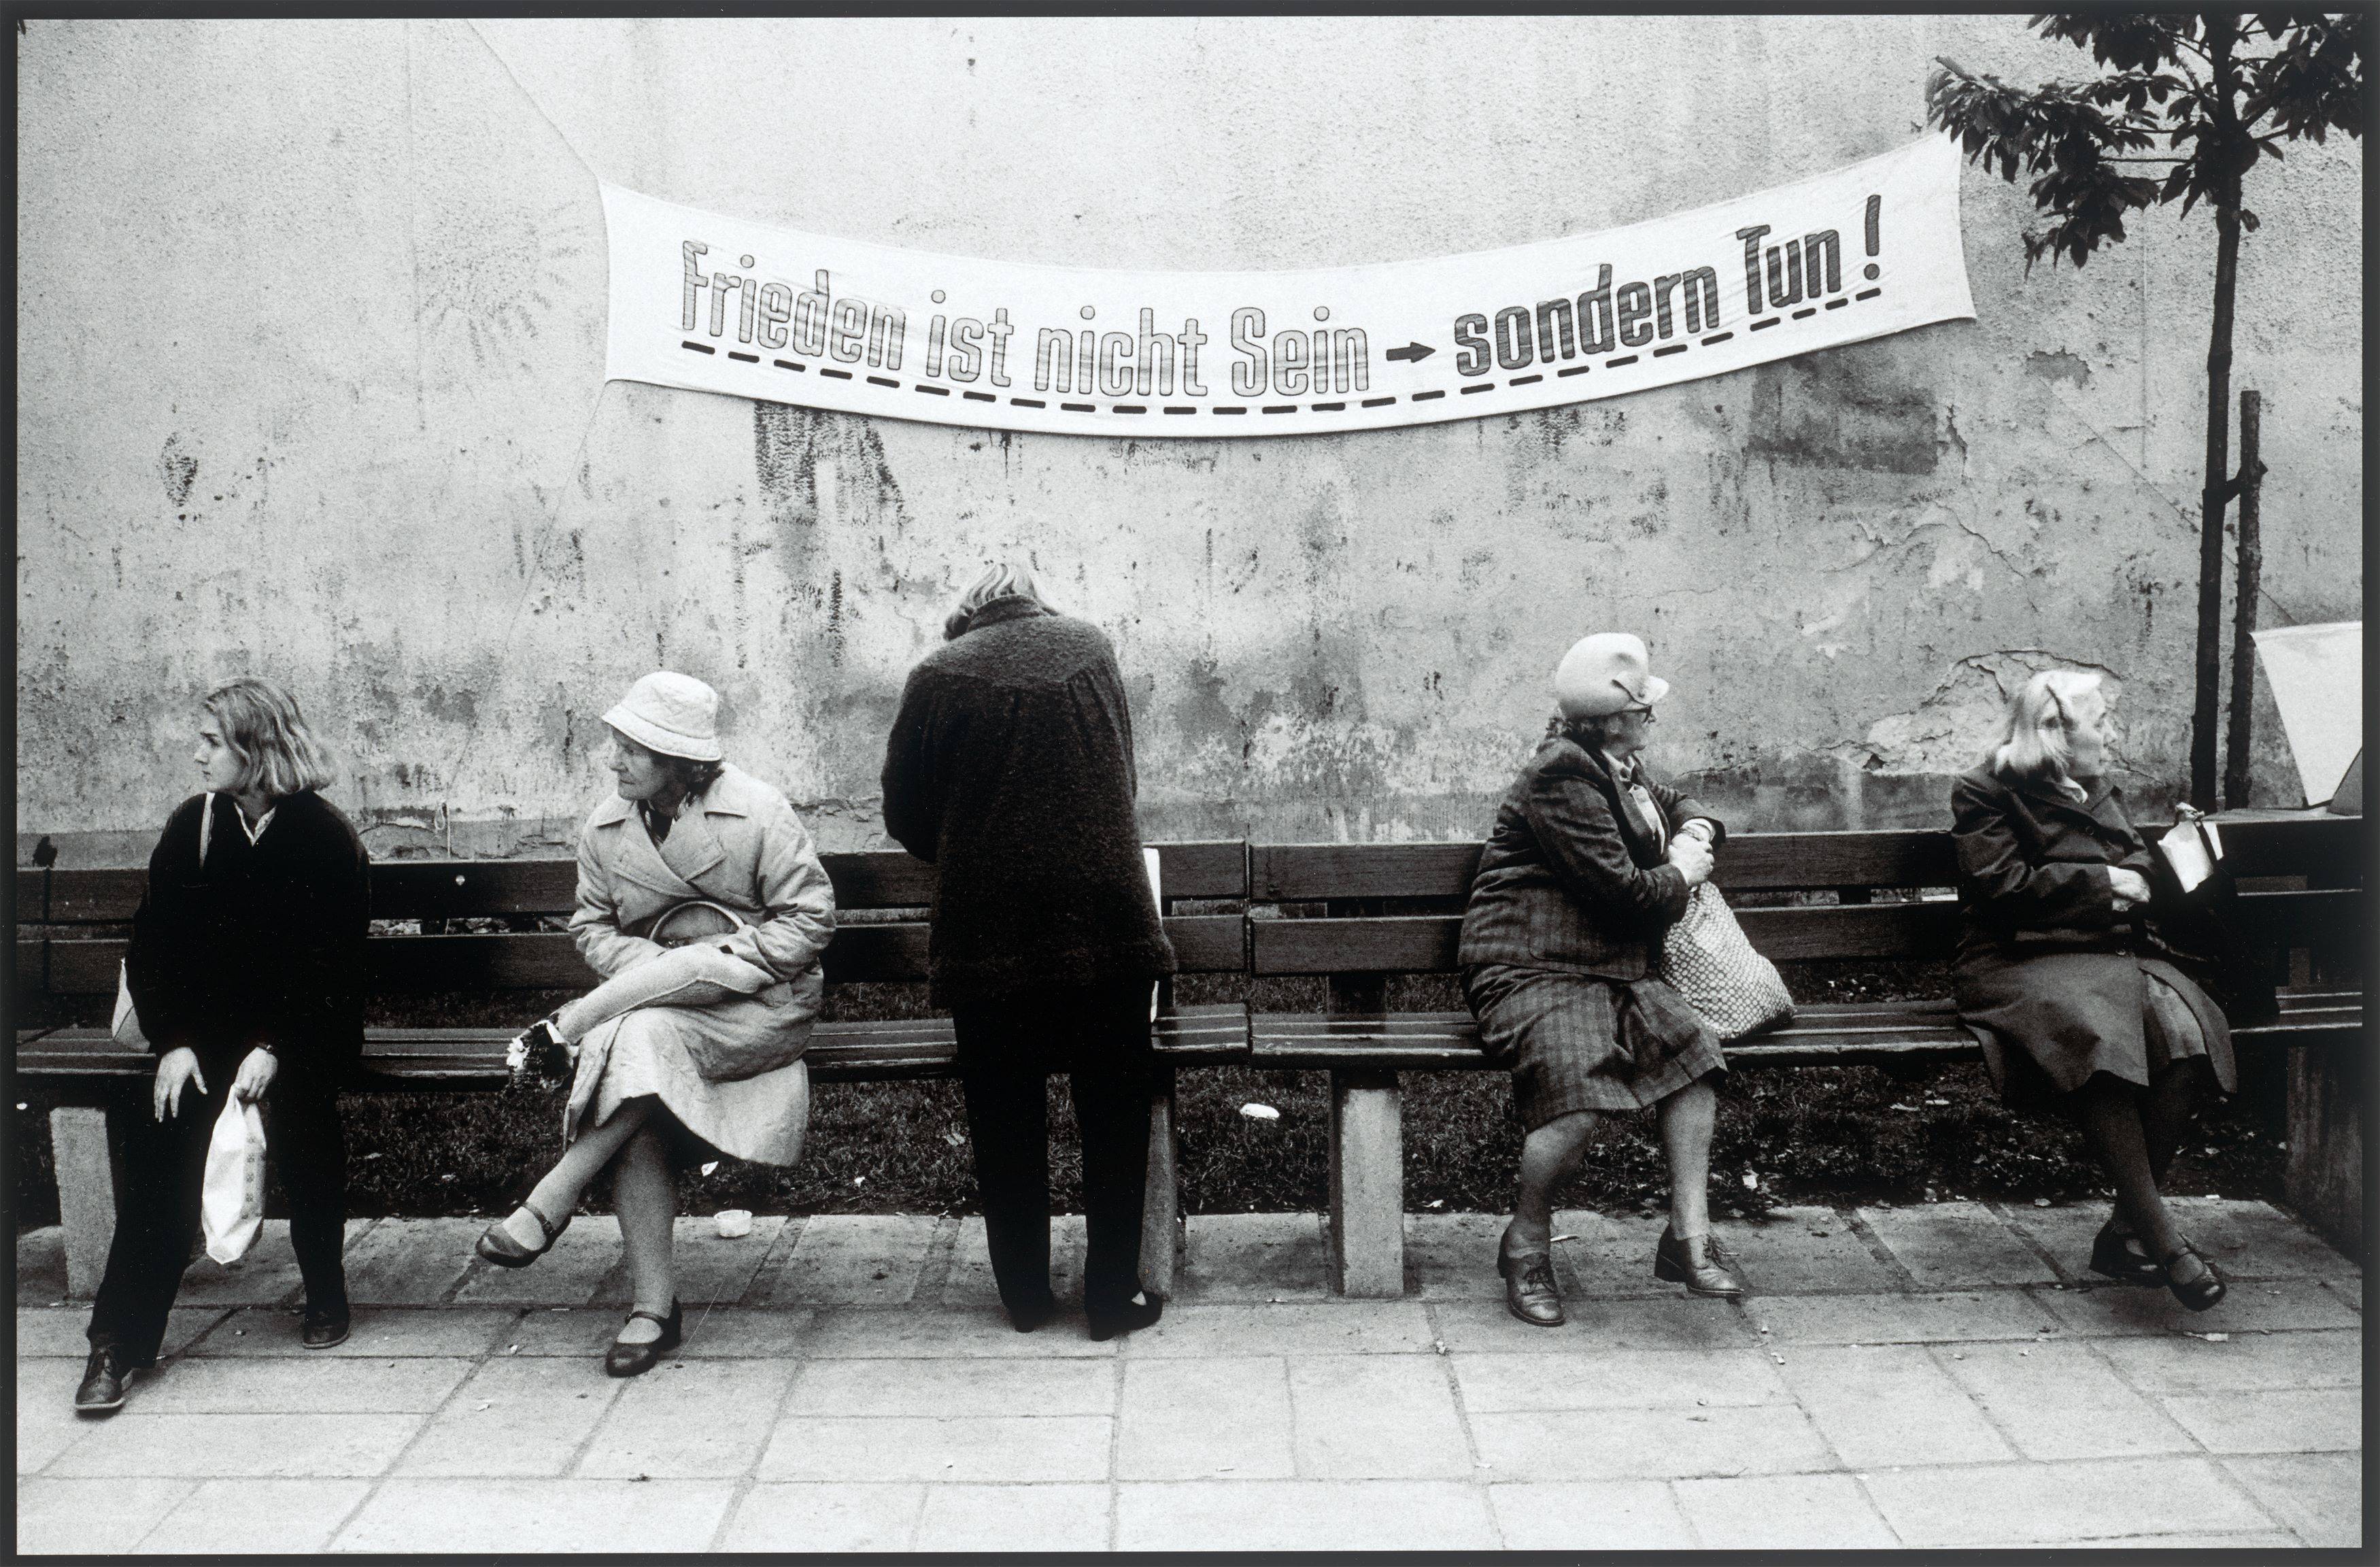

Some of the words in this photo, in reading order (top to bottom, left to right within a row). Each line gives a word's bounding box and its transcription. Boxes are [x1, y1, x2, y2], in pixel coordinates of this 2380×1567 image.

[682, 240, 906, 370] Frieden
[926, 290, 1015, 387] ist
[1034, 306, 1208, 397] nicht
[1231, 306, 1370, 397] Sein
[1454, 264, 1720, 377] sondern
